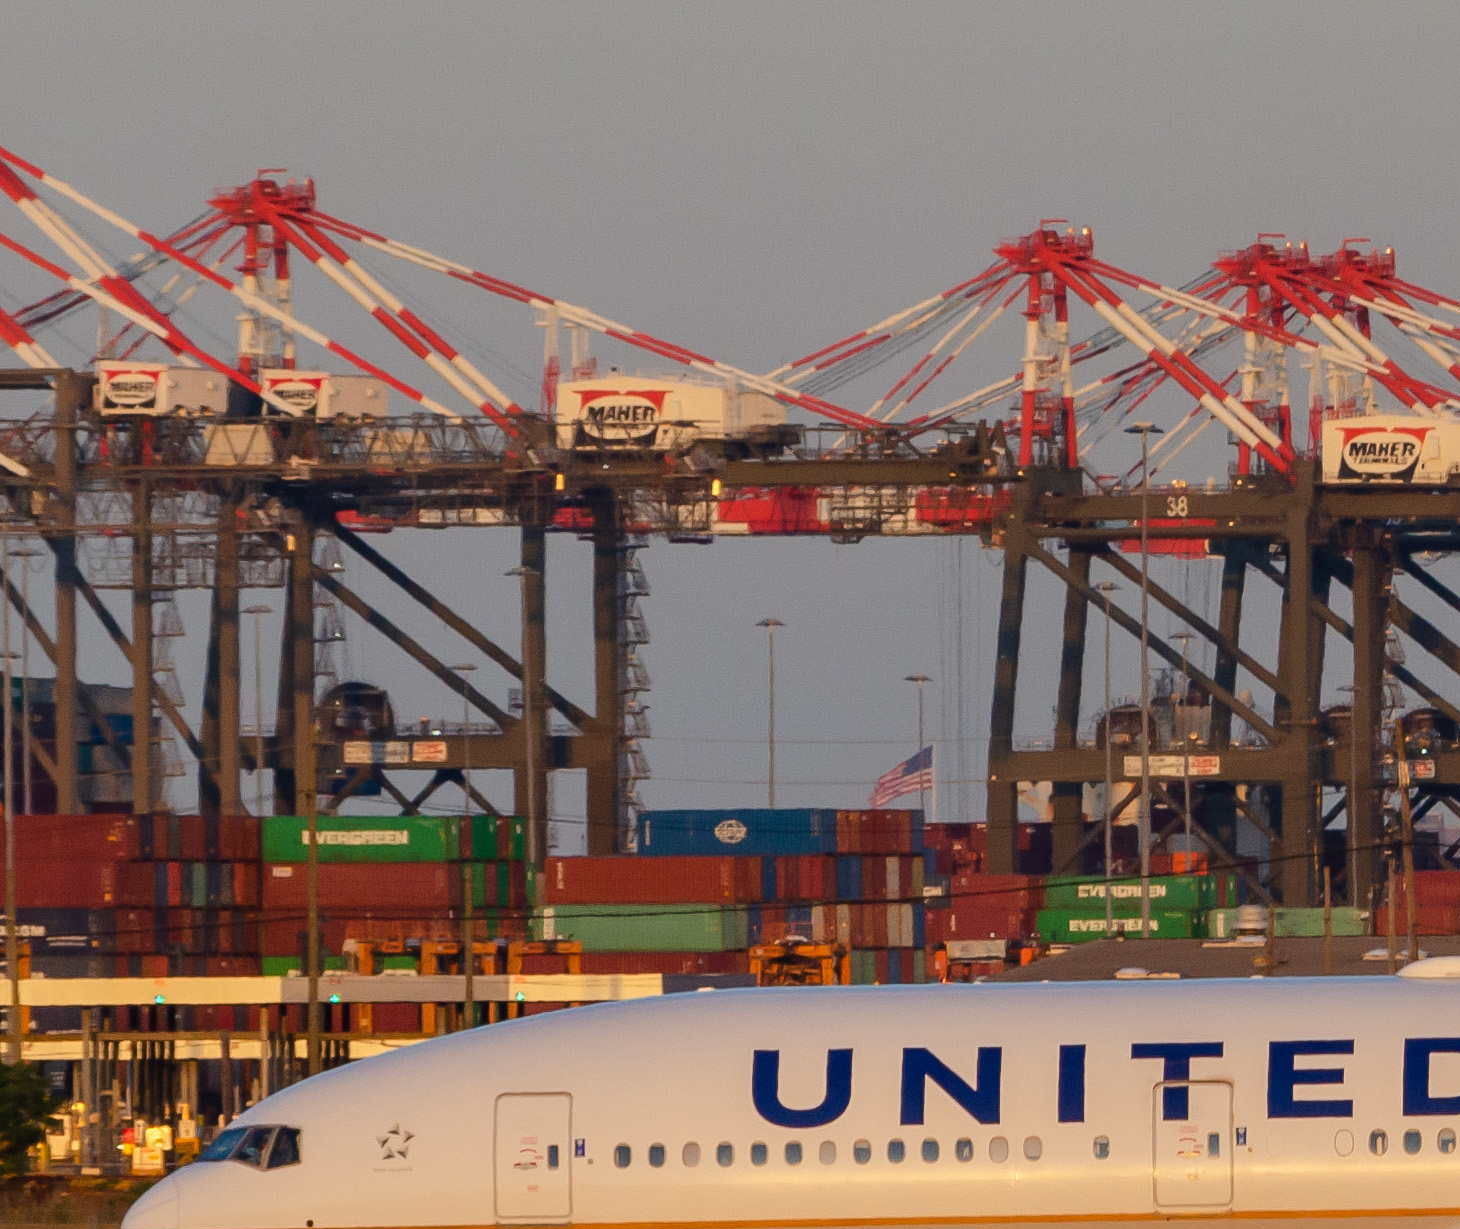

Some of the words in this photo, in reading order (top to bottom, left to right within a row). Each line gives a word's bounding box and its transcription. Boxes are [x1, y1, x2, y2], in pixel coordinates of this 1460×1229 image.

[587, 405, 656, 422] MAHER
[1349, 442, 1416, 457] MAHER
[302, 830, 409, 845] EVERGREEN
